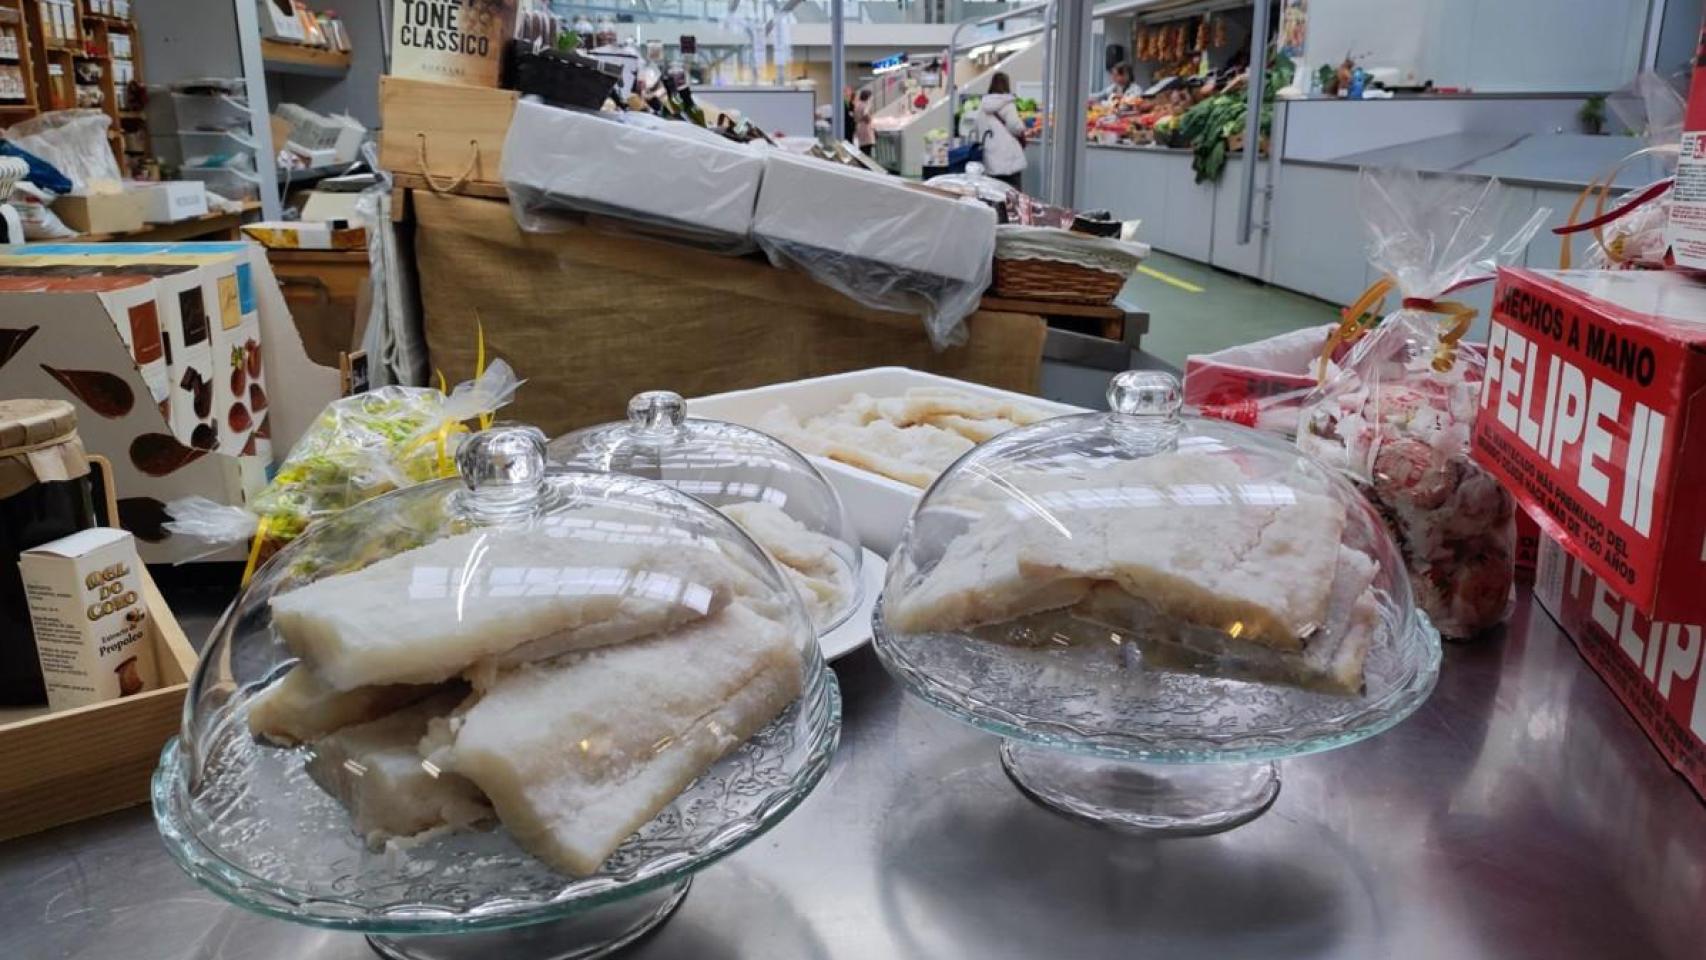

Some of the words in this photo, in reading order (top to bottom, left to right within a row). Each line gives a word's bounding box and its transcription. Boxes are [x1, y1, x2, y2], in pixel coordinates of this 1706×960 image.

[401, 0, 459, 30] TONE
[401, 25, 489, 57] CLASSICO
[1501, 286, 1564, 342] HECHOS
[1567, 316, 1580, 352] A
[1585, 322, 1656, 388] MANO
[1480, 319, 1621, 508] FELIPE
[1619, 401, 1665, 539] II
[1554, 484, 1605, 538] PREMIADO
[1606, 527, 1629, 560] DEL
[1566, 514, 1581, 537] DE
[1582, 528, 1601, 555] 120
[1604, 544, 1636, 586] AÑOS
